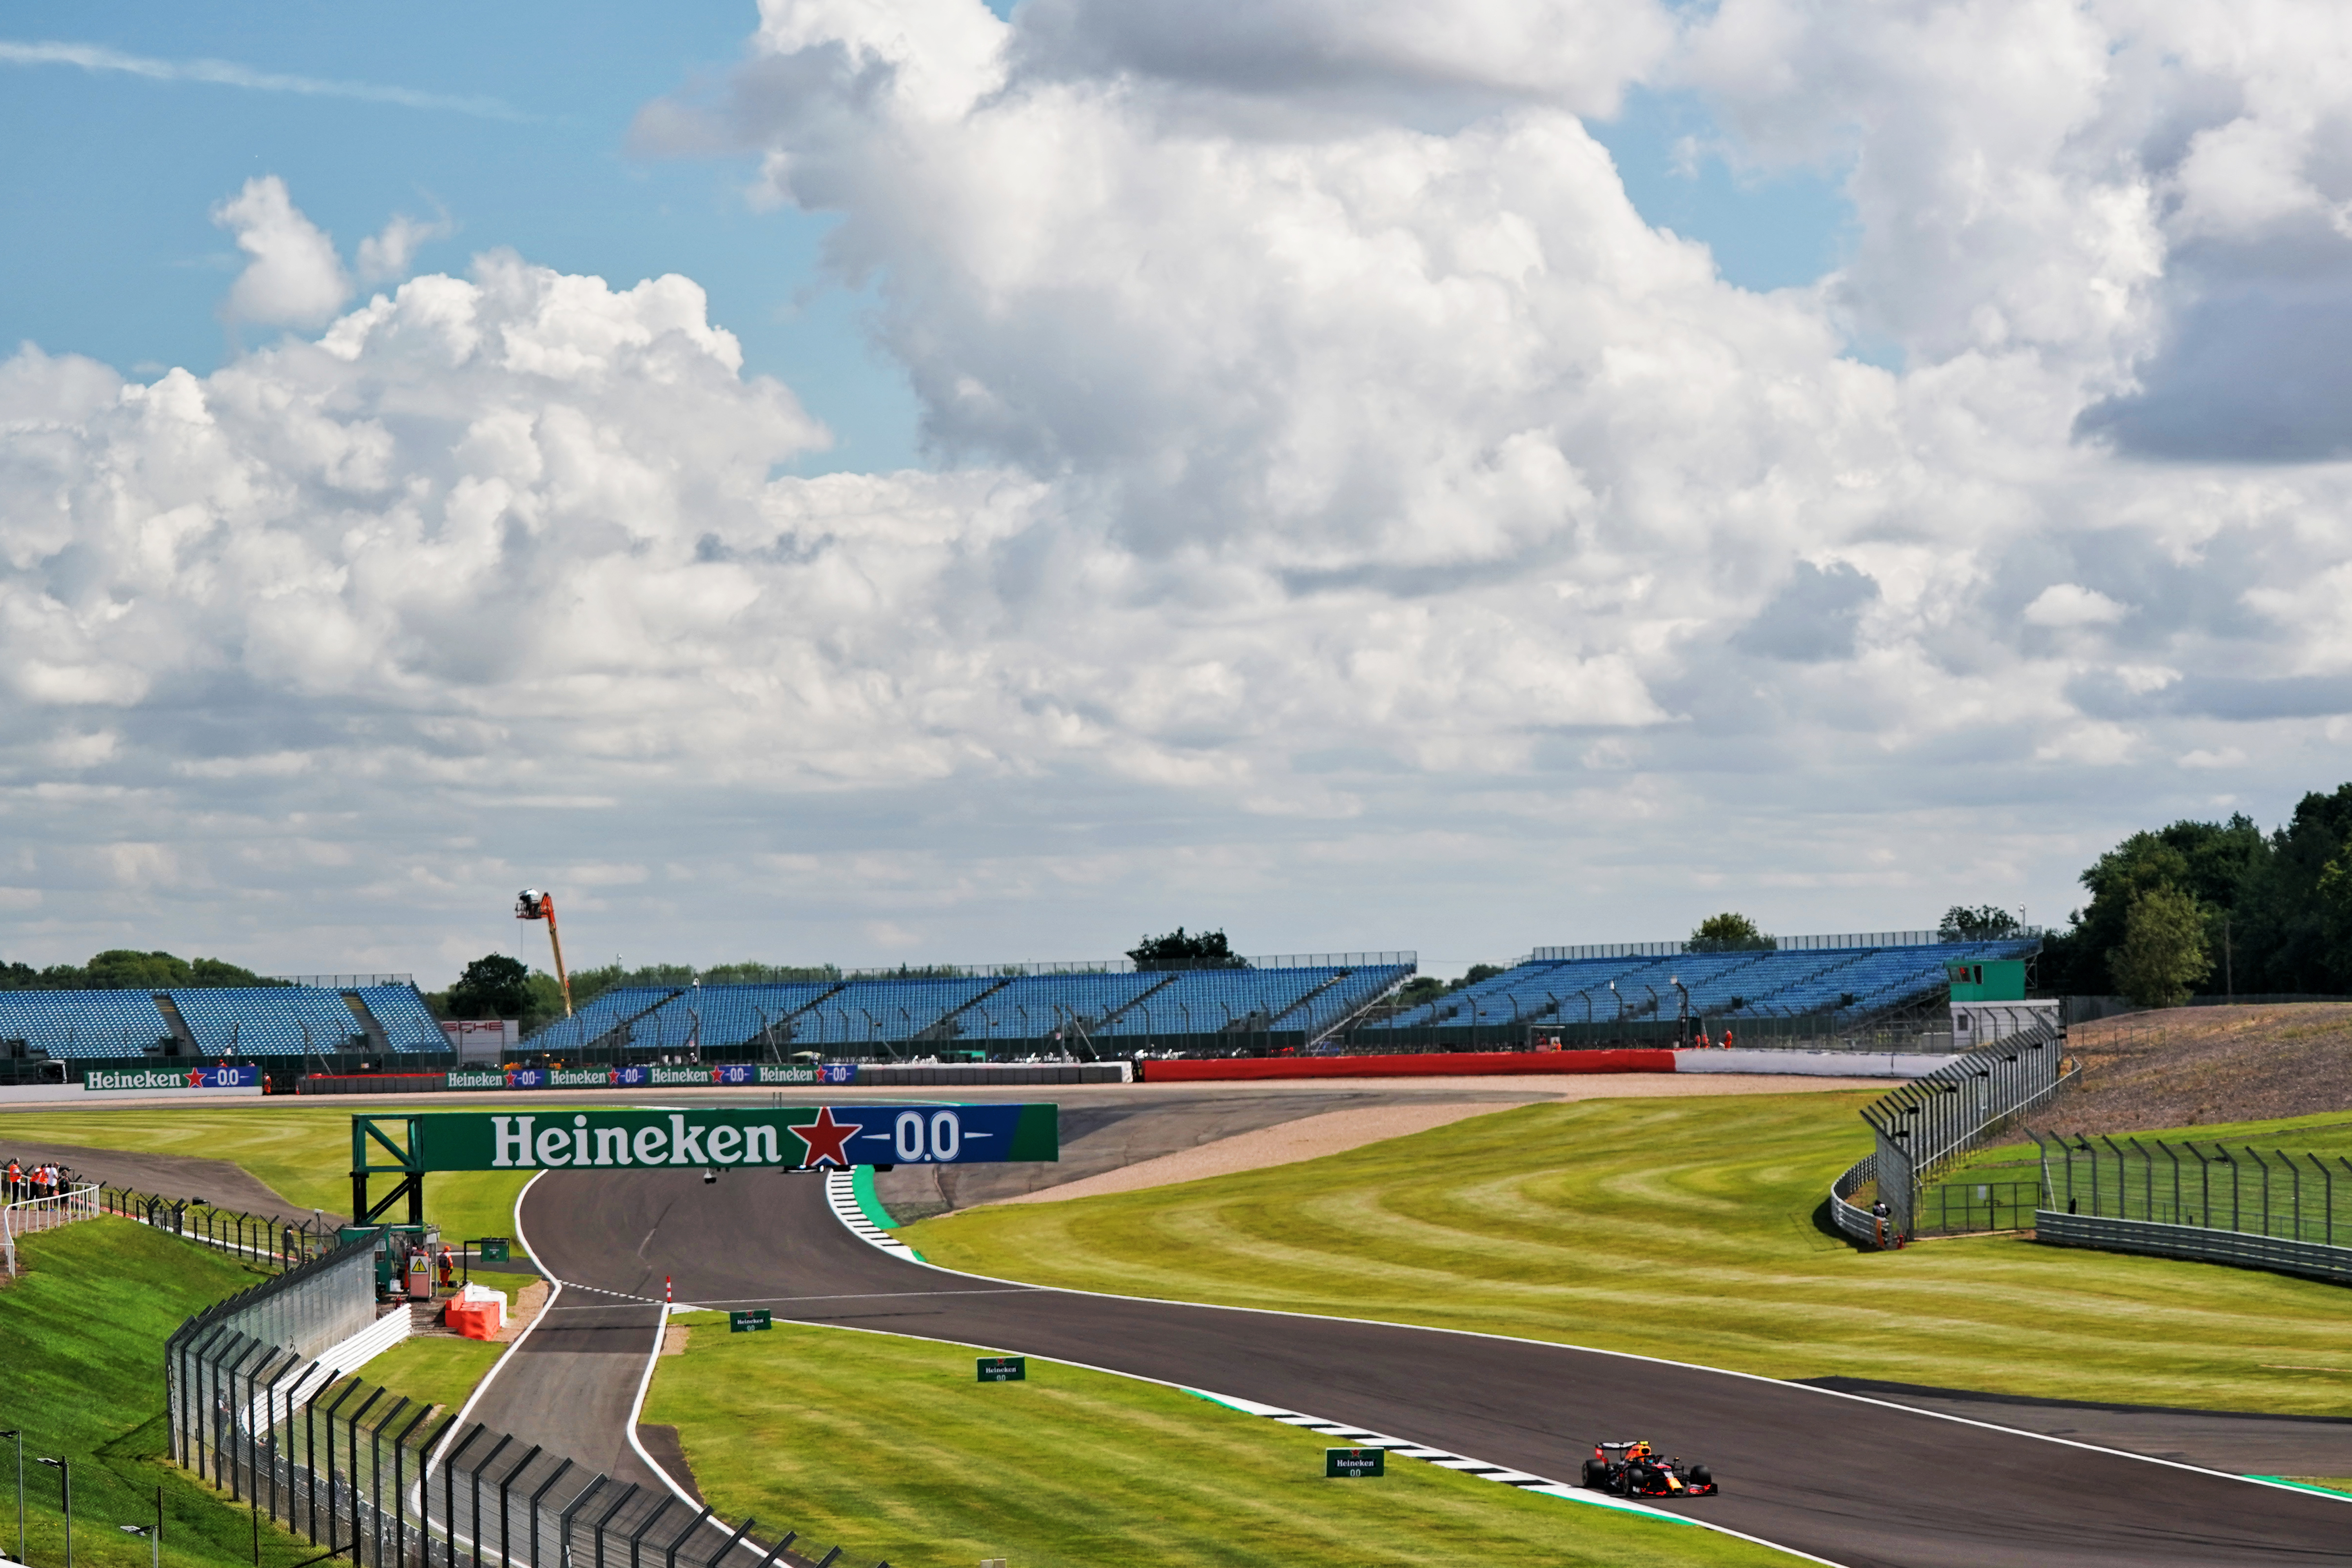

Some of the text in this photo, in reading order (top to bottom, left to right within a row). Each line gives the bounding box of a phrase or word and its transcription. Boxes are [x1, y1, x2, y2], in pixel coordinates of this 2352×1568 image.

[87, 1069, 239, 1089] Heineken 0.0
[448, 1072, 502, 1087] Heineken
[551, 1070, 606, 1085] Heineken
[652, 1067, 708, 1083] Heineken
[760, 1067, 813, 1082] Heineken
[491, 1111, 960, 1166] Heineken 0.0
